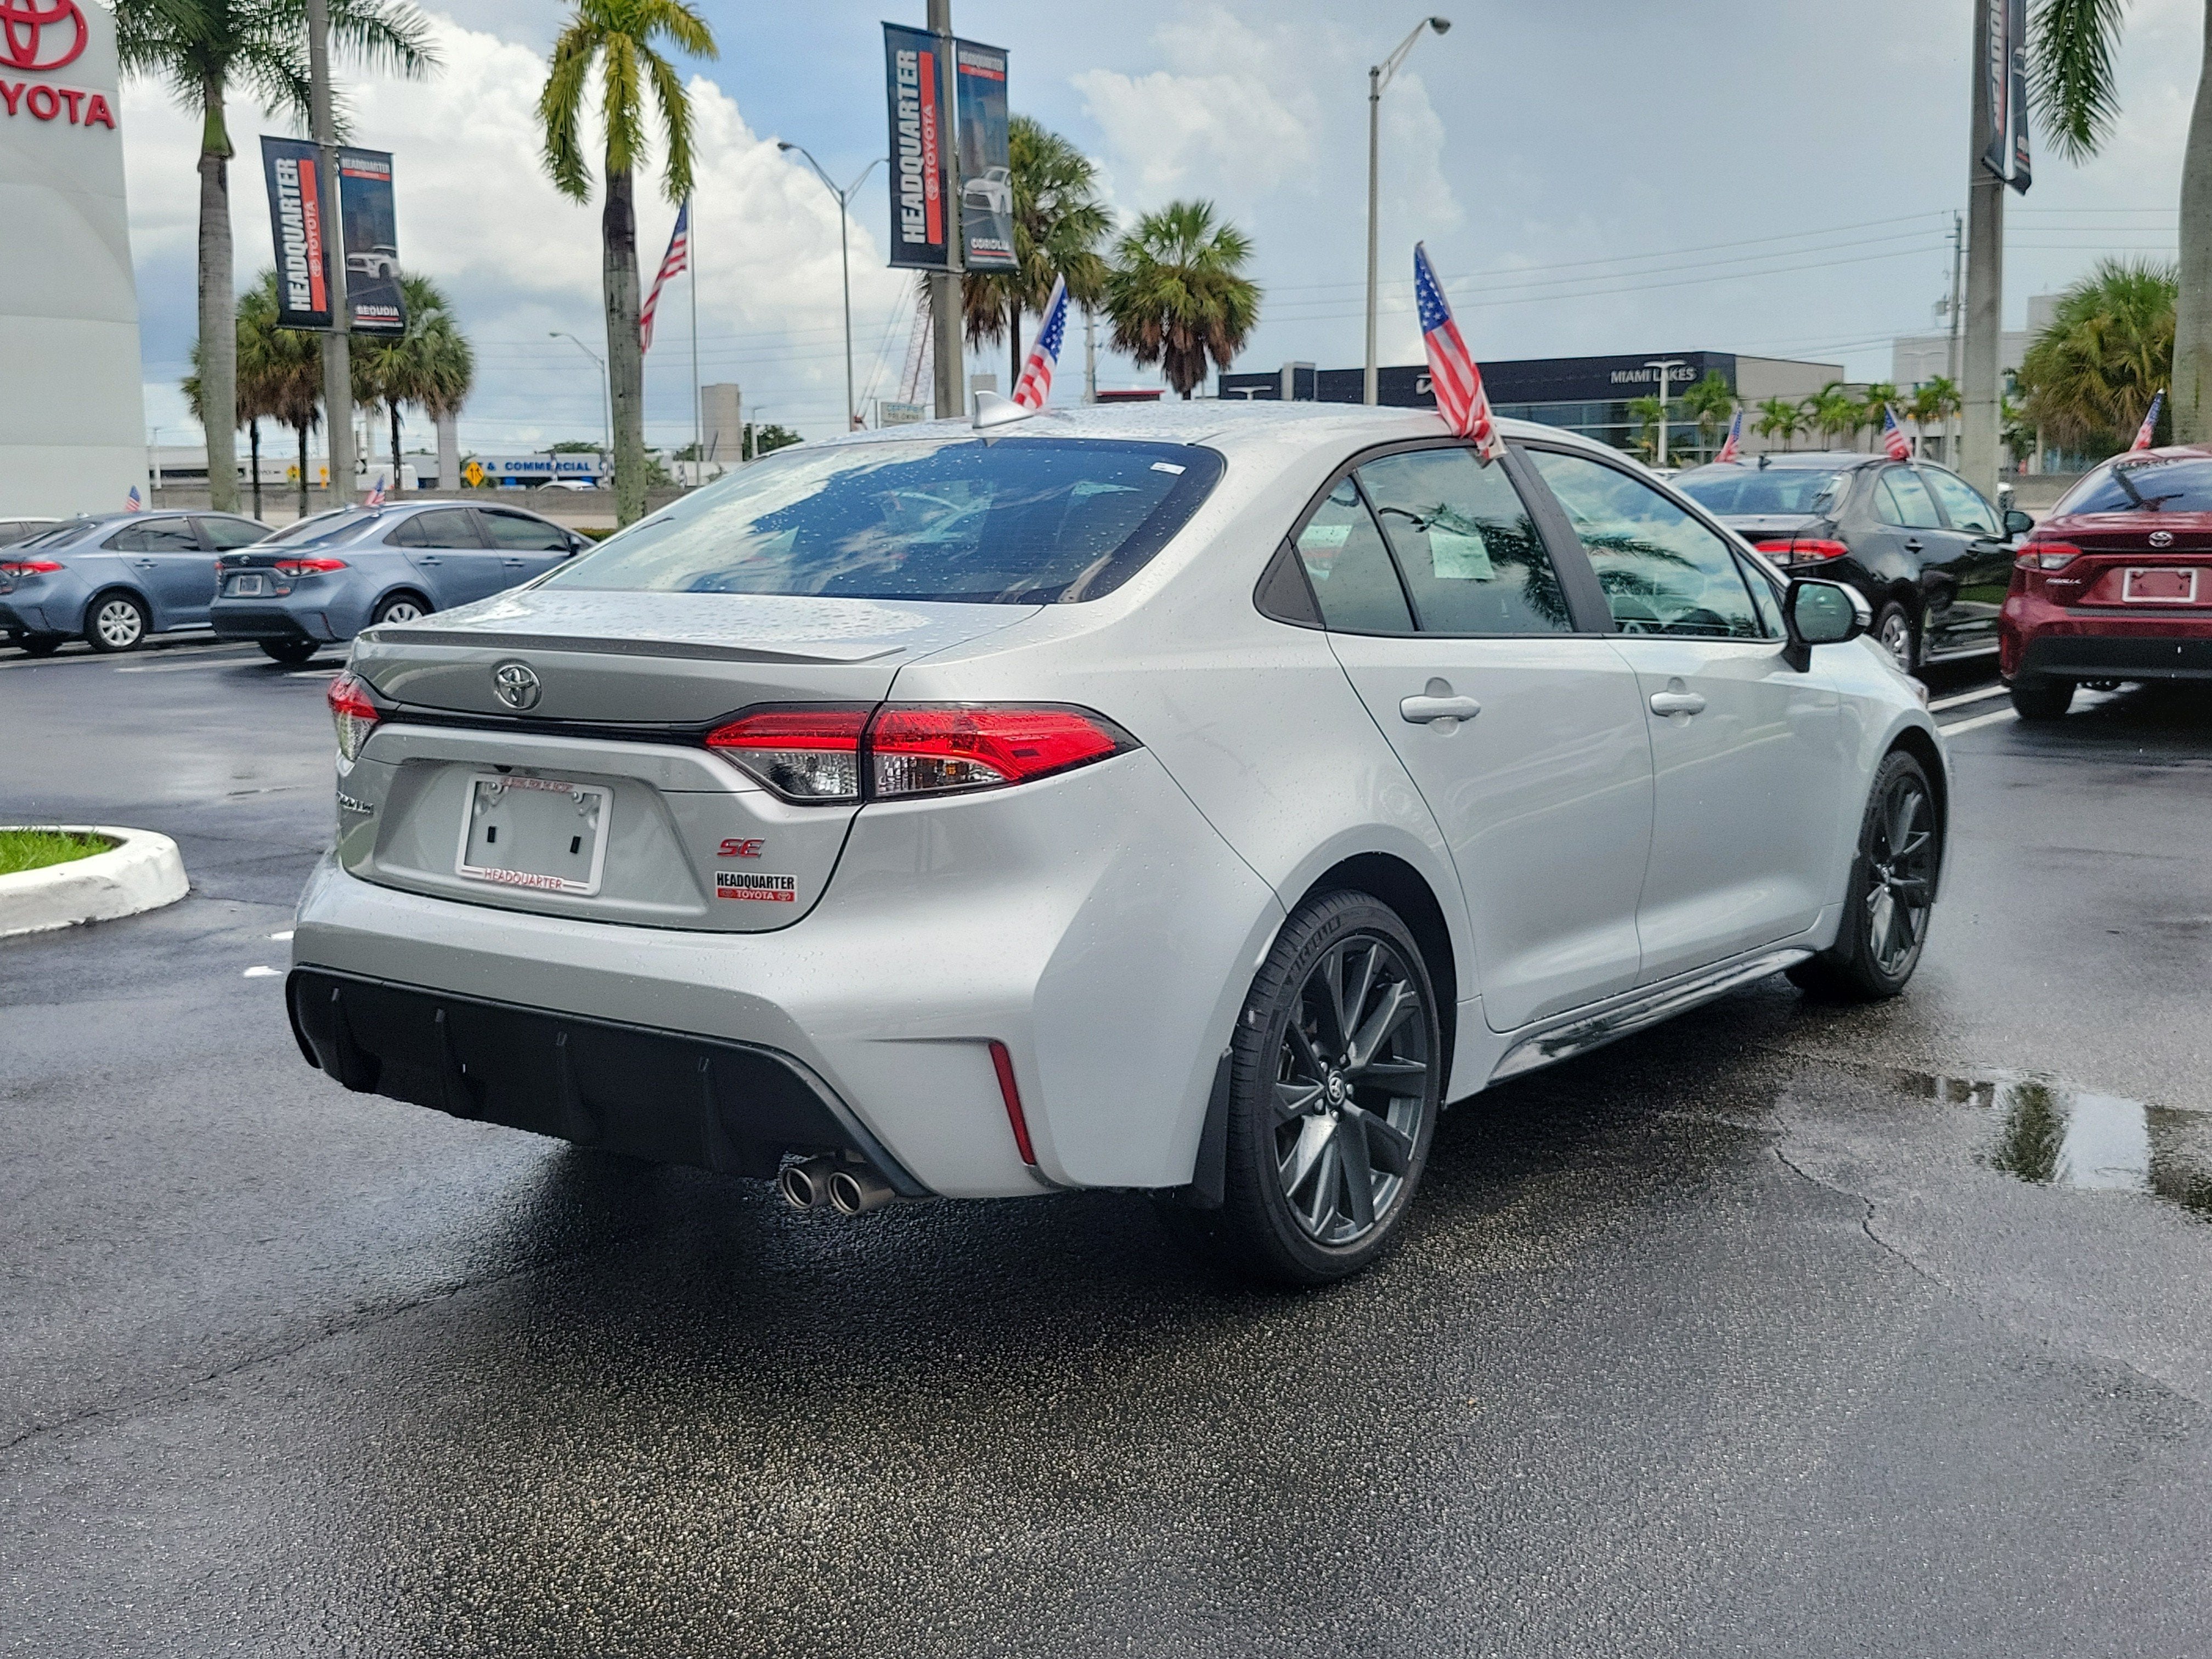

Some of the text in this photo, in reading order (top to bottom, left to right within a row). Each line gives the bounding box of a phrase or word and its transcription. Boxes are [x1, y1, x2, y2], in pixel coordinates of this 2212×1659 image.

[896, 50, 926, 244] HEADQUARTER
[922, 104, 936, 174] TOYOTA
[275, 157, 311, 311] HEADQUARTER
[304, 201, 320, 256] TOYOTA
[356, 305, 400, 317] SEQUOIA
[1611, 366, 1697, 384] MIAMI LKES
[716, 837, 766, 857] SE
[484, 867, 563, 889] HEADQUARTER
[716, 873, 794, 890] HEADQUARTER
[736, 890, 775, 900] TOYOTA
